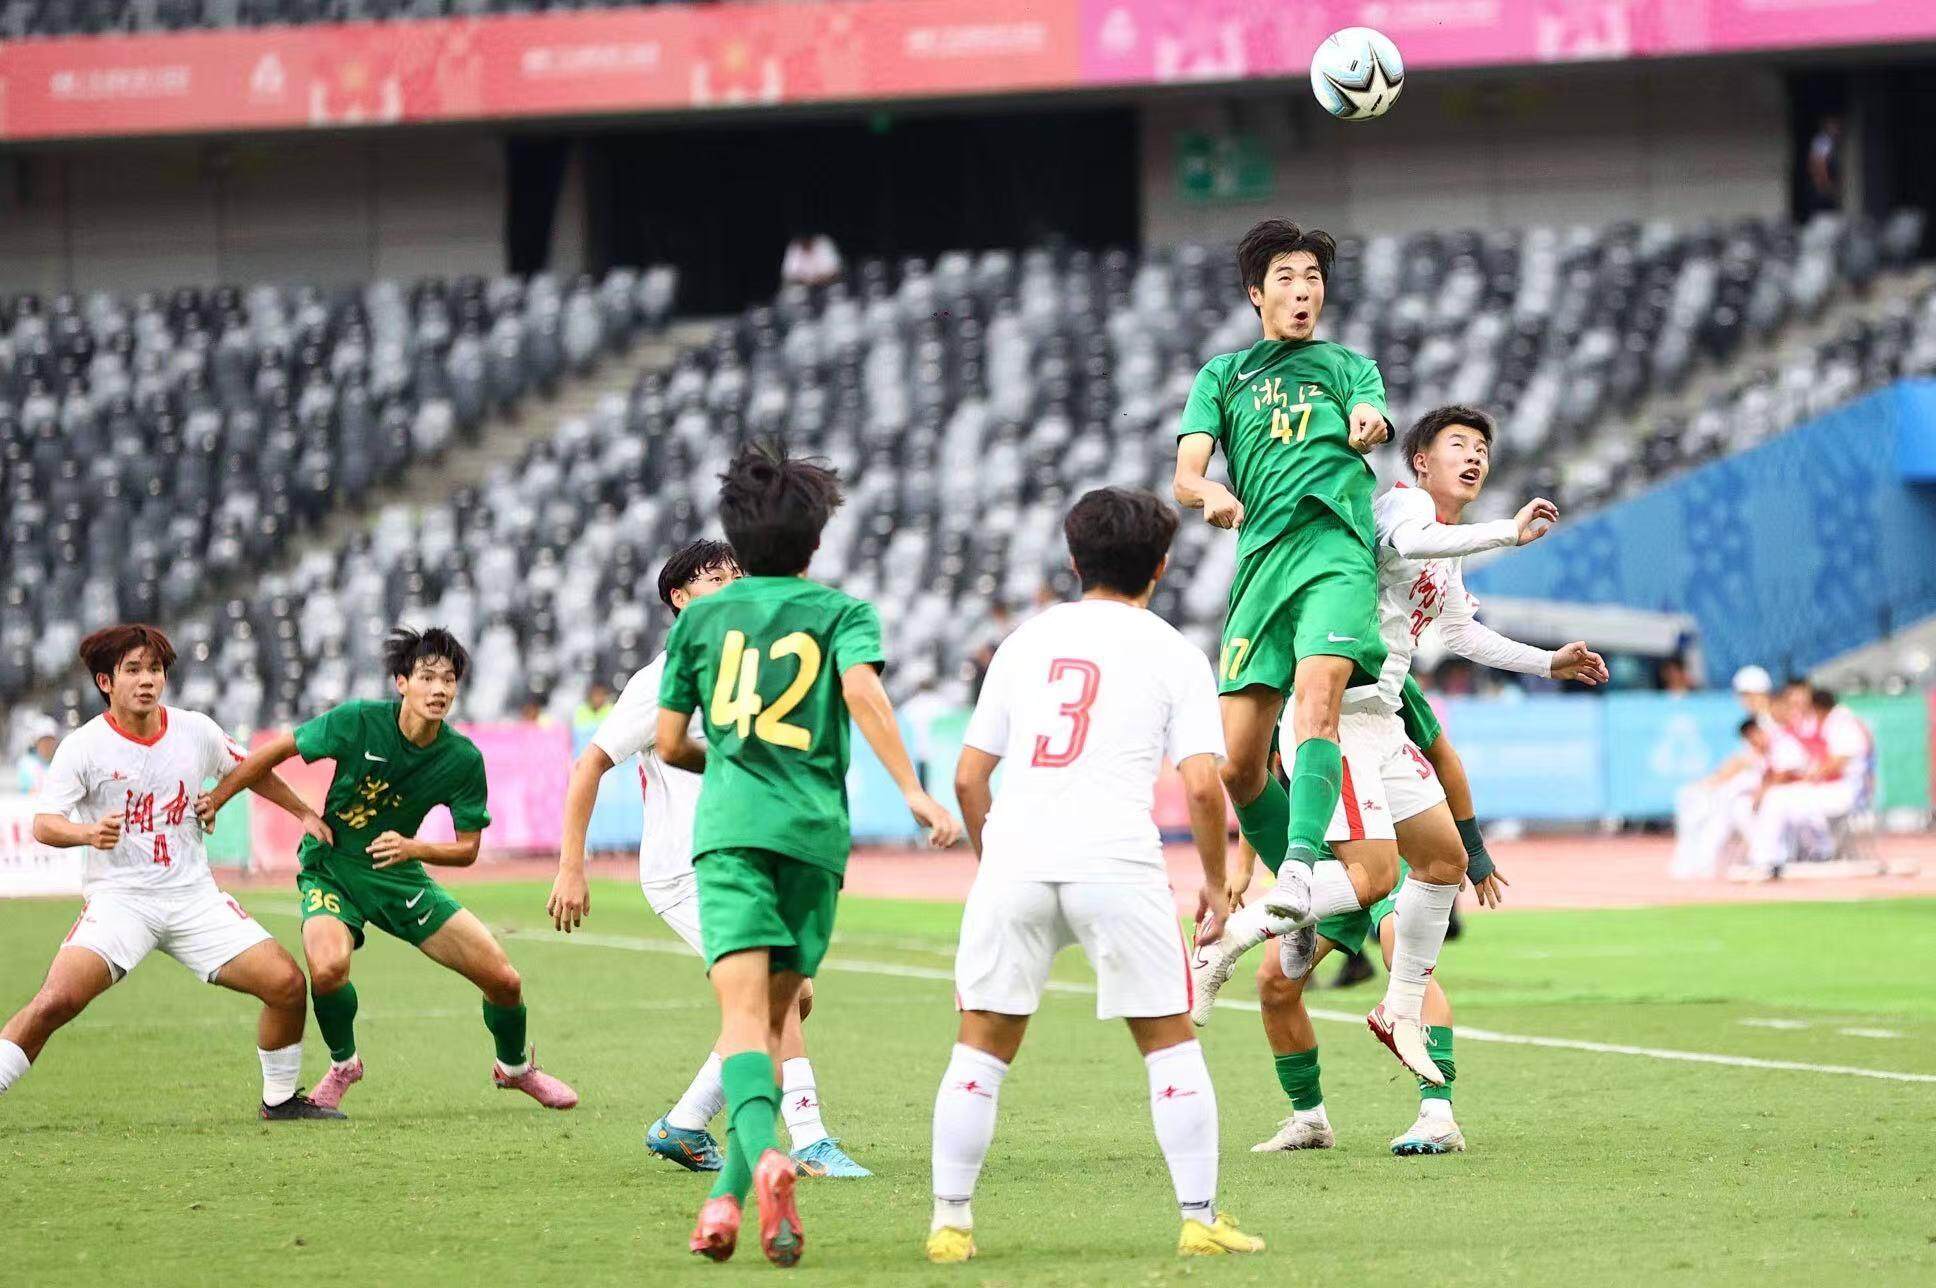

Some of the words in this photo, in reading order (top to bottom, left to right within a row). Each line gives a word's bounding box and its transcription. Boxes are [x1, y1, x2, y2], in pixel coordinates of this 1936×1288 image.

[1269, 403, 1313, 445] 47
[710, 629, 821, 752] 42
[1031, 658, 1101, 768] 3
[125, 780, 190, 834] 湖南
[153, 833, 171, 867] 4
[308, 888, 341, 914] 36
